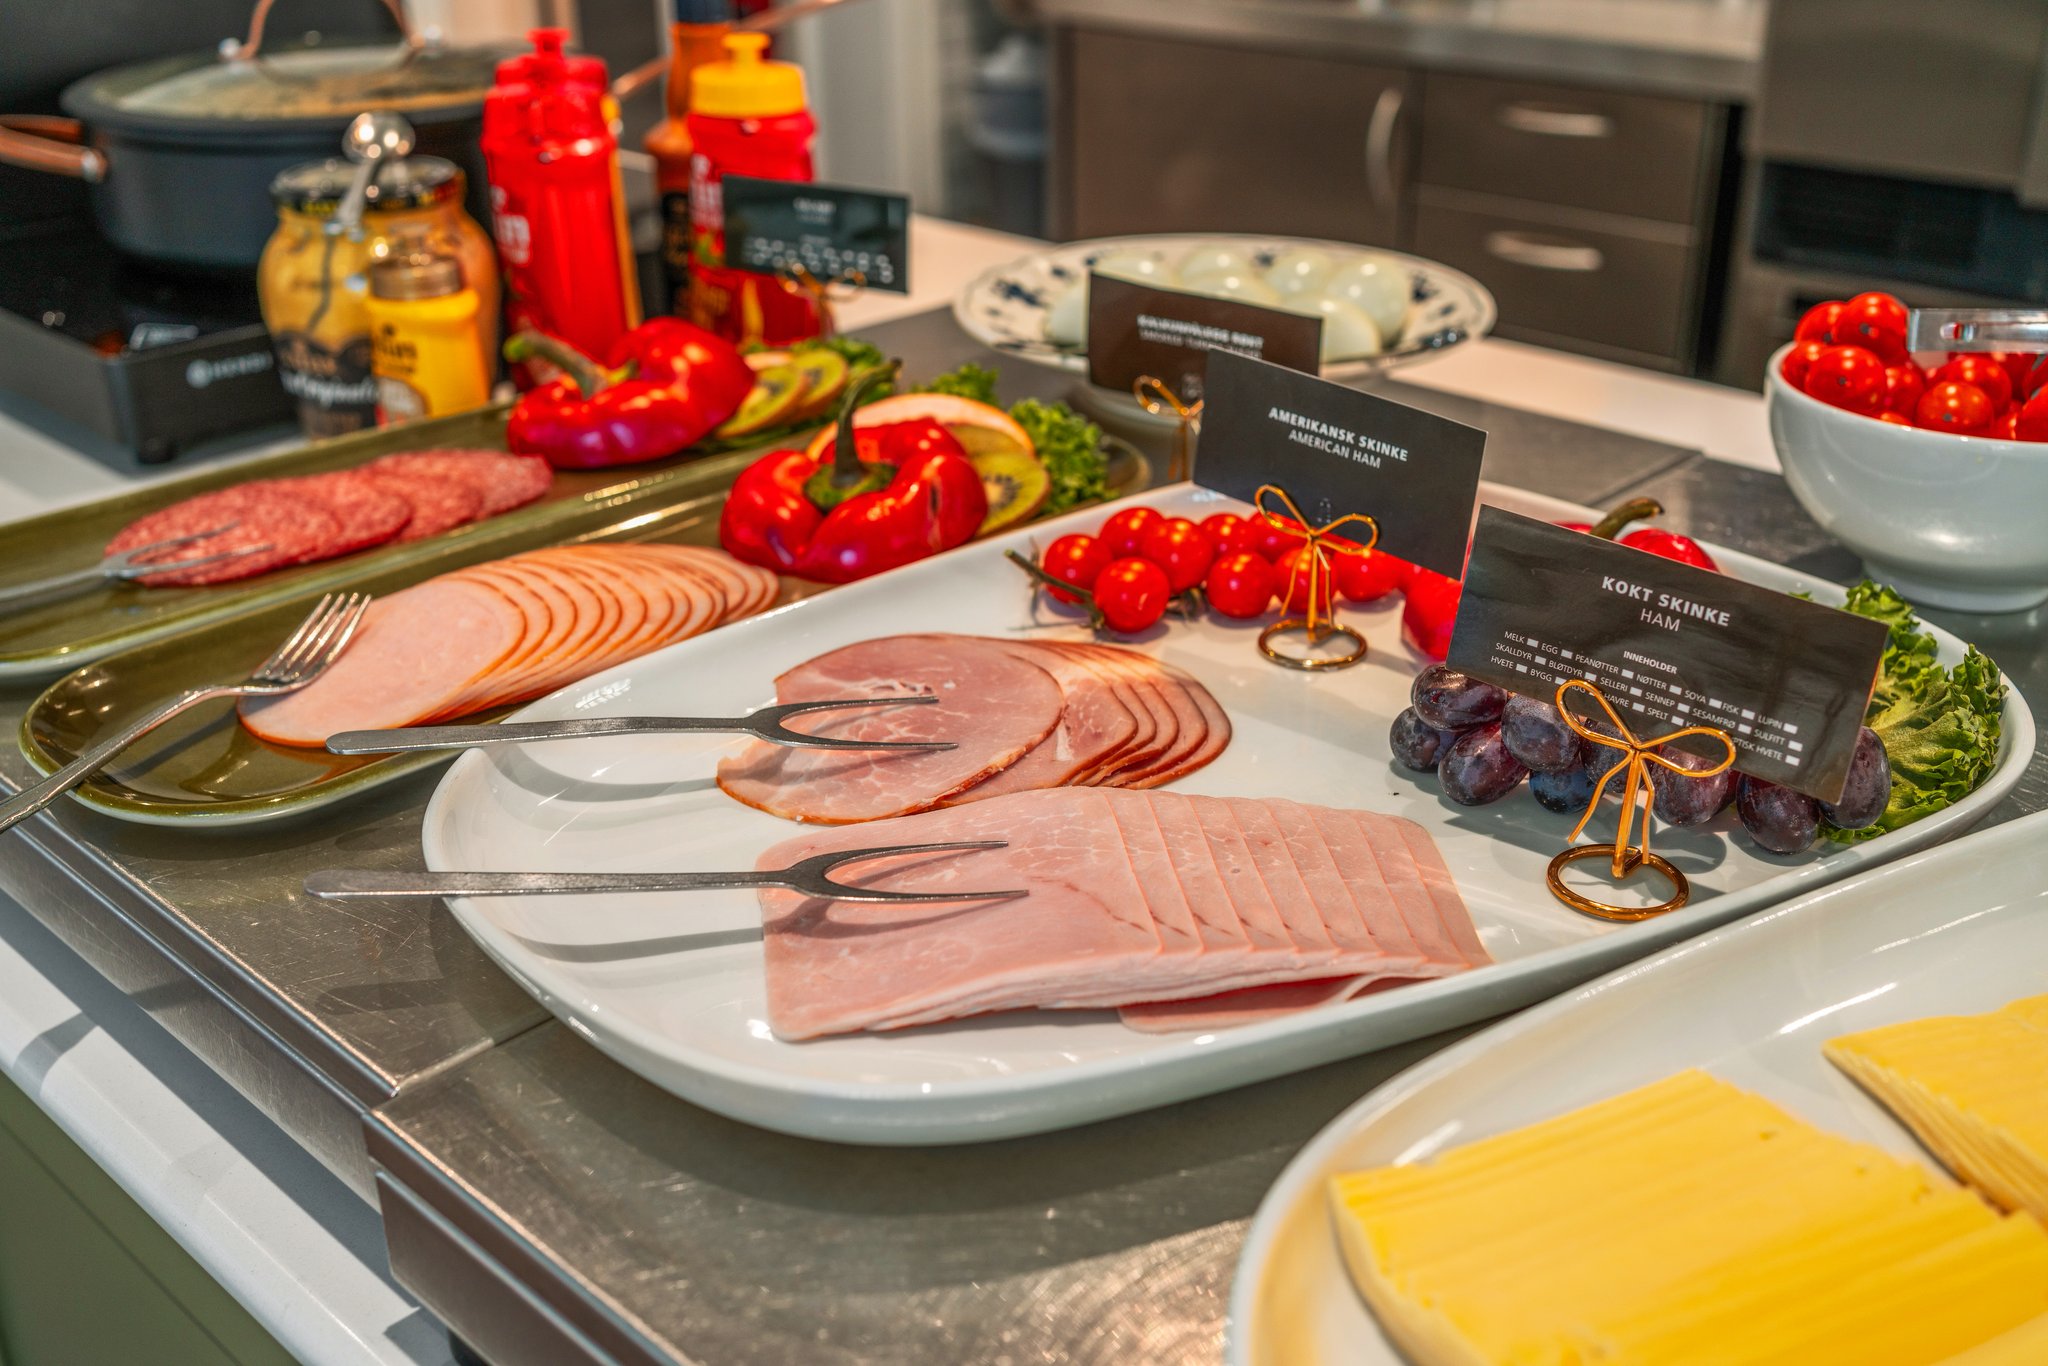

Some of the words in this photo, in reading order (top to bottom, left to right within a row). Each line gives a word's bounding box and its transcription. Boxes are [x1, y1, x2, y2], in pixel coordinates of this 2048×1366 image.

[1268, 406, 1356, 445] AMERIKANSK
[1358, 435, 1409, 462] SKINKE
[1288, 429, 1350, 459] AMERICAN
[1352, 449, 1381, 469] HAM
[1601, 575, 1654, 602] KOKT
[1658, 593, 1731, 627] SKINKE
[1640, 608, 1681, 632] HAM
[1504, 631, 1525, 644] MELK
[1541, 643, 1558, 655] EGG
[1575, 654, 1619, 675] PEANØTTER
[1636, 674, 1668, 691] NØTTER
[1684, 690, 1707, 704] SOYA
[1721, 702, 1740, 715] FISK
[1757, 715, 1783, 730] LUPIN
[1623, 650, 1678, 675] INNEHOLDER
[1490, 655, 1514, 669] HVETE
[1530, 668, 1553, 682] BYGG
[1604, 692, 1630, 708] HAVRE
[1647, 707, 1669, 720] SPELT
[1756, 746, 1783, 761] HVETE
[1495, 642, 1532, 661] SKALLDYR
[1548, 660, 1583, 678] BLØTDYR
[1600, 676, 1628, 692] SELLERI
[1644, 691, 1676, 707] SENNEP
[1691, 707, 1736, 729] SESAMFRØ
[1753, 729, 1786, 746] SULFITT
